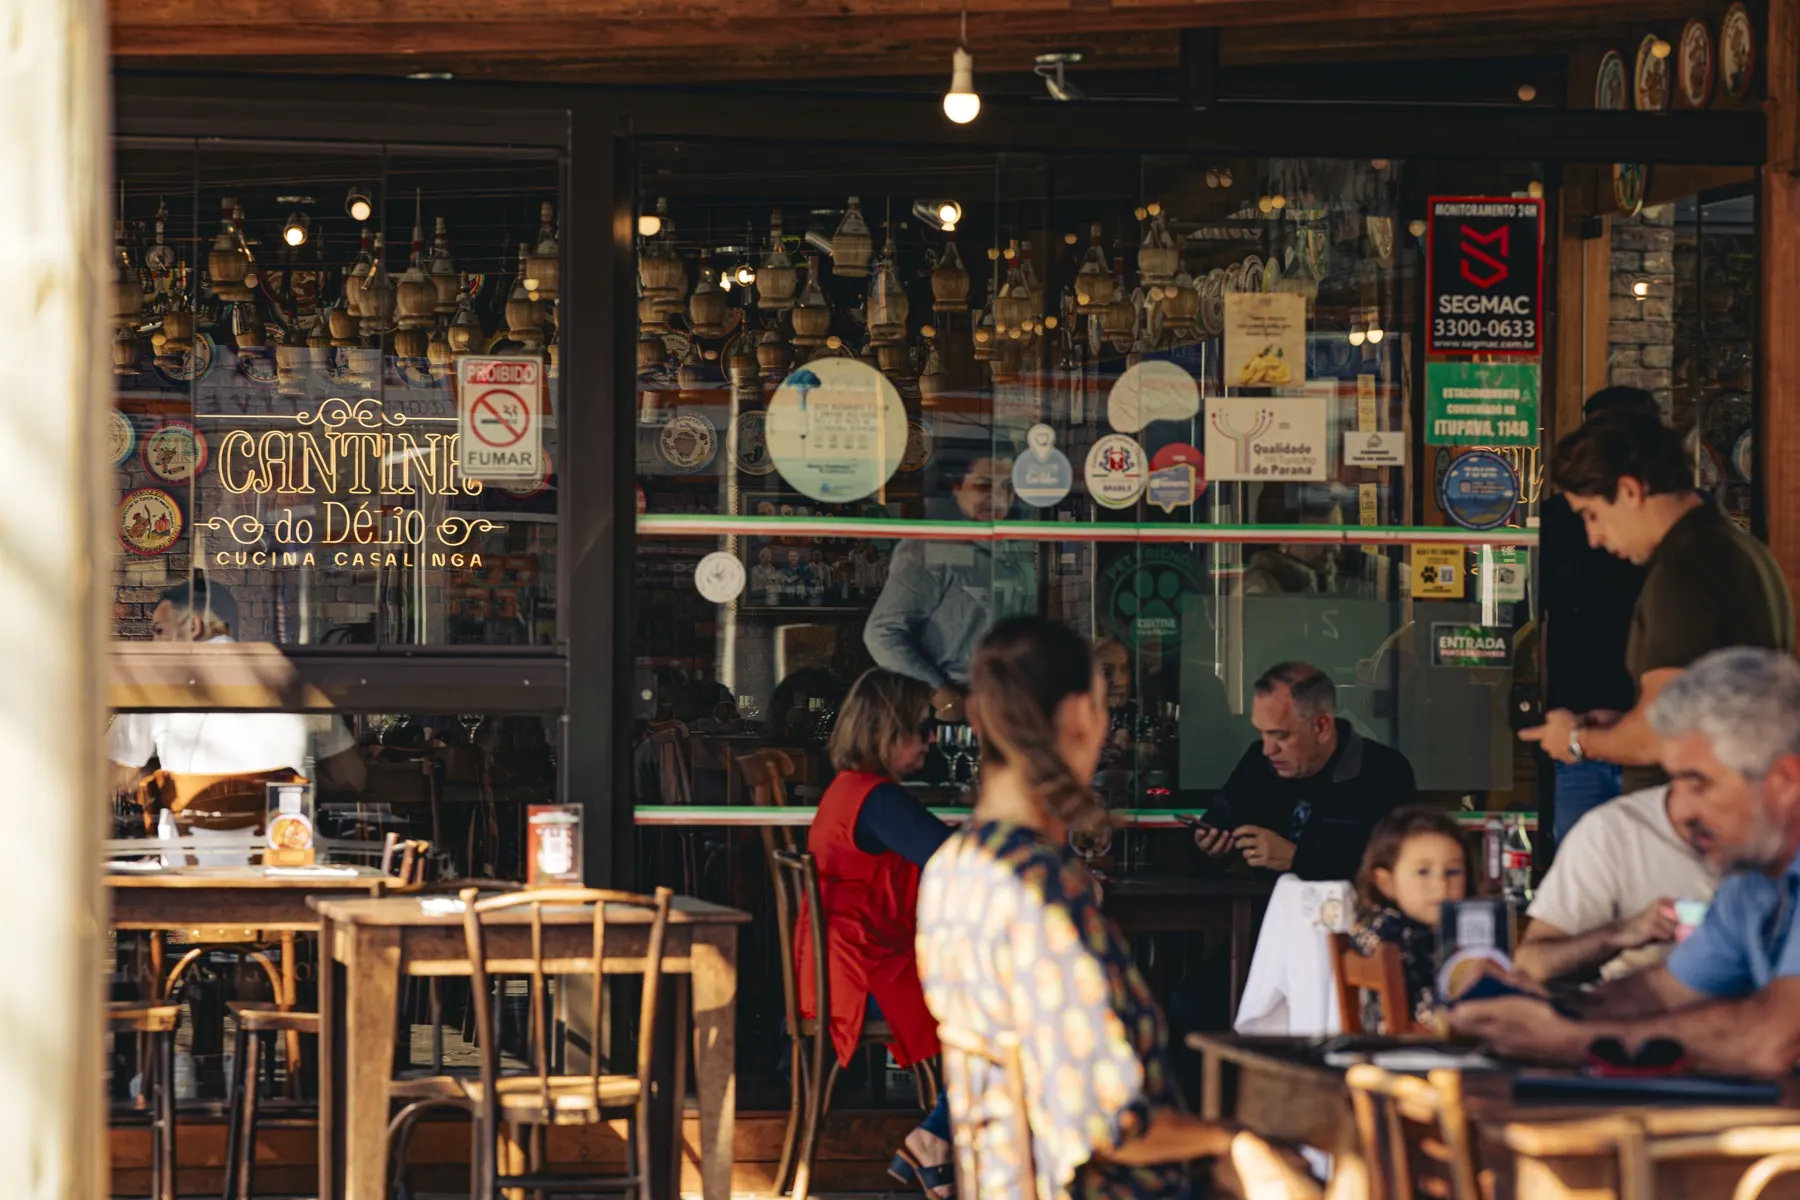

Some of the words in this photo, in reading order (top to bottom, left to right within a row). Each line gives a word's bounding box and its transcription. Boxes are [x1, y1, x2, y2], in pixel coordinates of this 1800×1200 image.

[1435, 203, 1516, 217] MONITORAMENTO
[1518, 204, 1537, 217] 24H
[1439, 294, 1530, 315] SEGMAC
[1434, 319, 1535, 338] 3300-0633
[1433, 340, 1535, 350] www.segmac.com.br
[466, 364, 536, 384] PROIBIDO
[1434, 419, 1494, 438] ITUPAVA,
[1253, 443, 1312, 456] Qualidade
[467, 450, 533, 467] FUMAR
[1253, 464, 1268, 475] do
[274, 508, 314, 544] do
[216, 551, 316, 567] CUCINA
[334, 552, 484, 568] CASALINGA
[1439, 636, 1507, 650] ENTRADA
